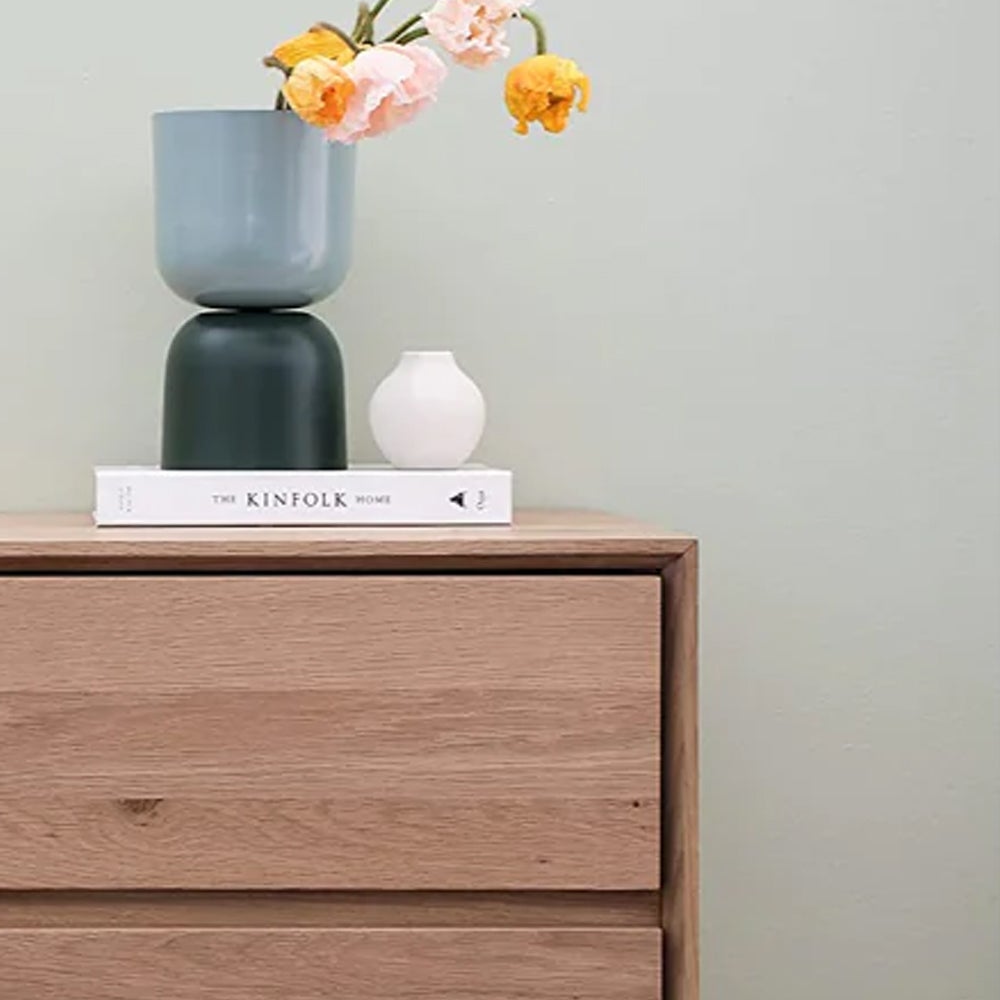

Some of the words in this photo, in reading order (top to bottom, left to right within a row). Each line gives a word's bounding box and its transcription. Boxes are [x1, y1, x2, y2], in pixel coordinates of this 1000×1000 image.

[211, 494, 236, 504] THE
[246, 492, 348, 508] KINFOLK
[355, 494, 392, 504] HOME
